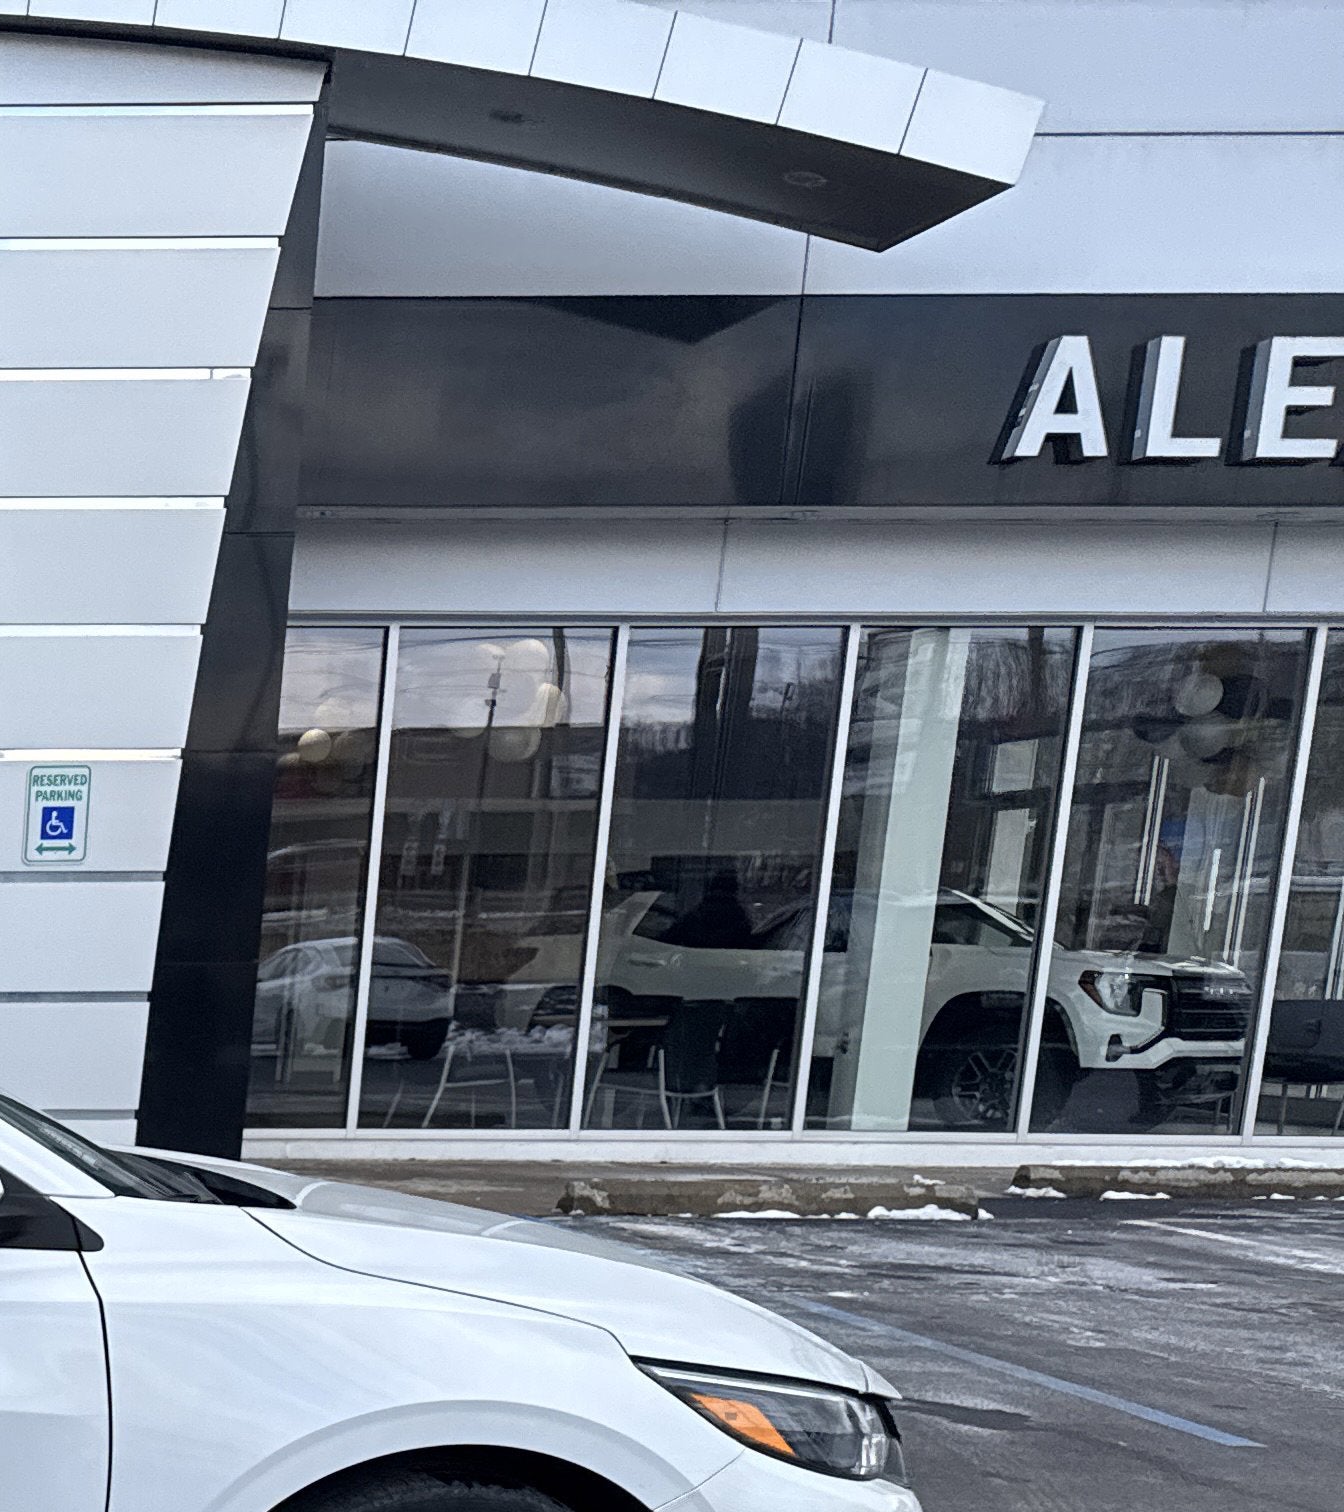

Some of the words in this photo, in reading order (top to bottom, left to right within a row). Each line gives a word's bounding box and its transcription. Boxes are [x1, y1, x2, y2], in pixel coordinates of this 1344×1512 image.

[1000, 334, 1344, 461] ALE
[32, 774, 87, 786] RESERVED
[35, 789, 82, 801] PARKING
